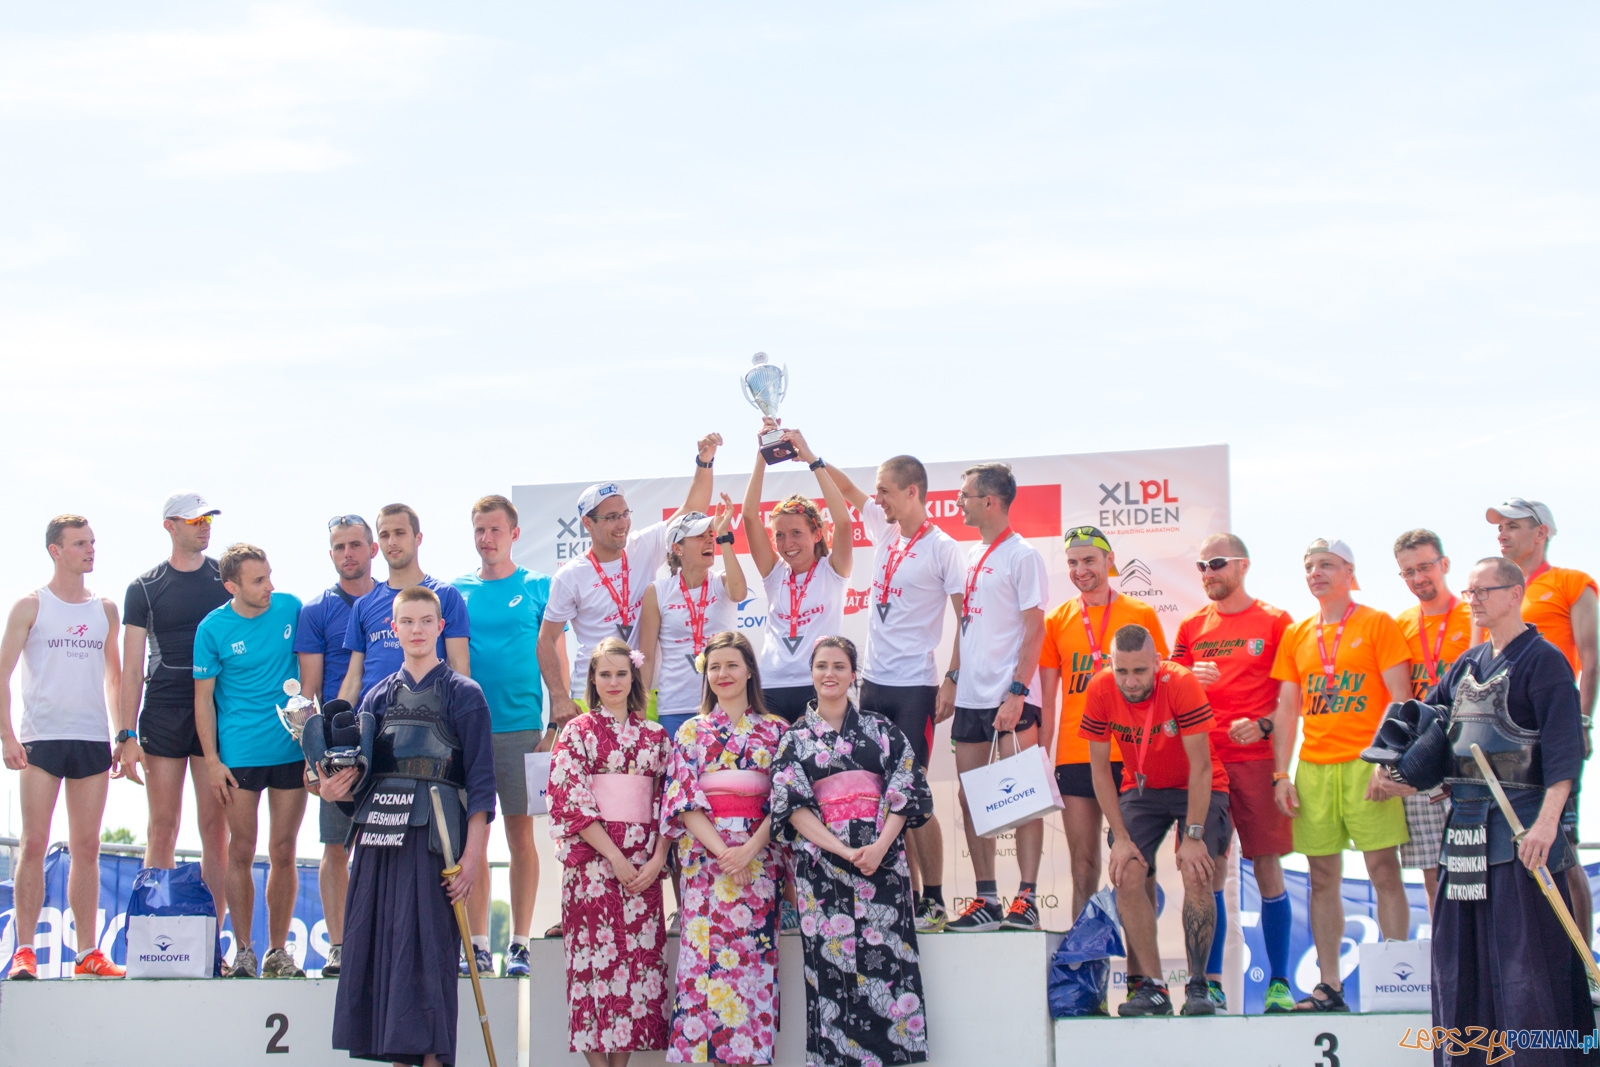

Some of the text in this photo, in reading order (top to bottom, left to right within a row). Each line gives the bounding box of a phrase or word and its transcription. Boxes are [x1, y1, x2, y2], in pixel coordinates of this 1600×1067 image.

[1099, 506, 1180, 527] EKIDEN
[47, 638, 103, 650] WITKOWO
[66, 650, 89, 660] biega
[372, 793, 415, 805] POZNAN
[985, 786, 1037, 813] MEDICOVER
[139, 954, 190, 962] MEDICOVER
[265, 1013, 290, 1054] 2
[1314, 1032, 1340, 1067] 3
